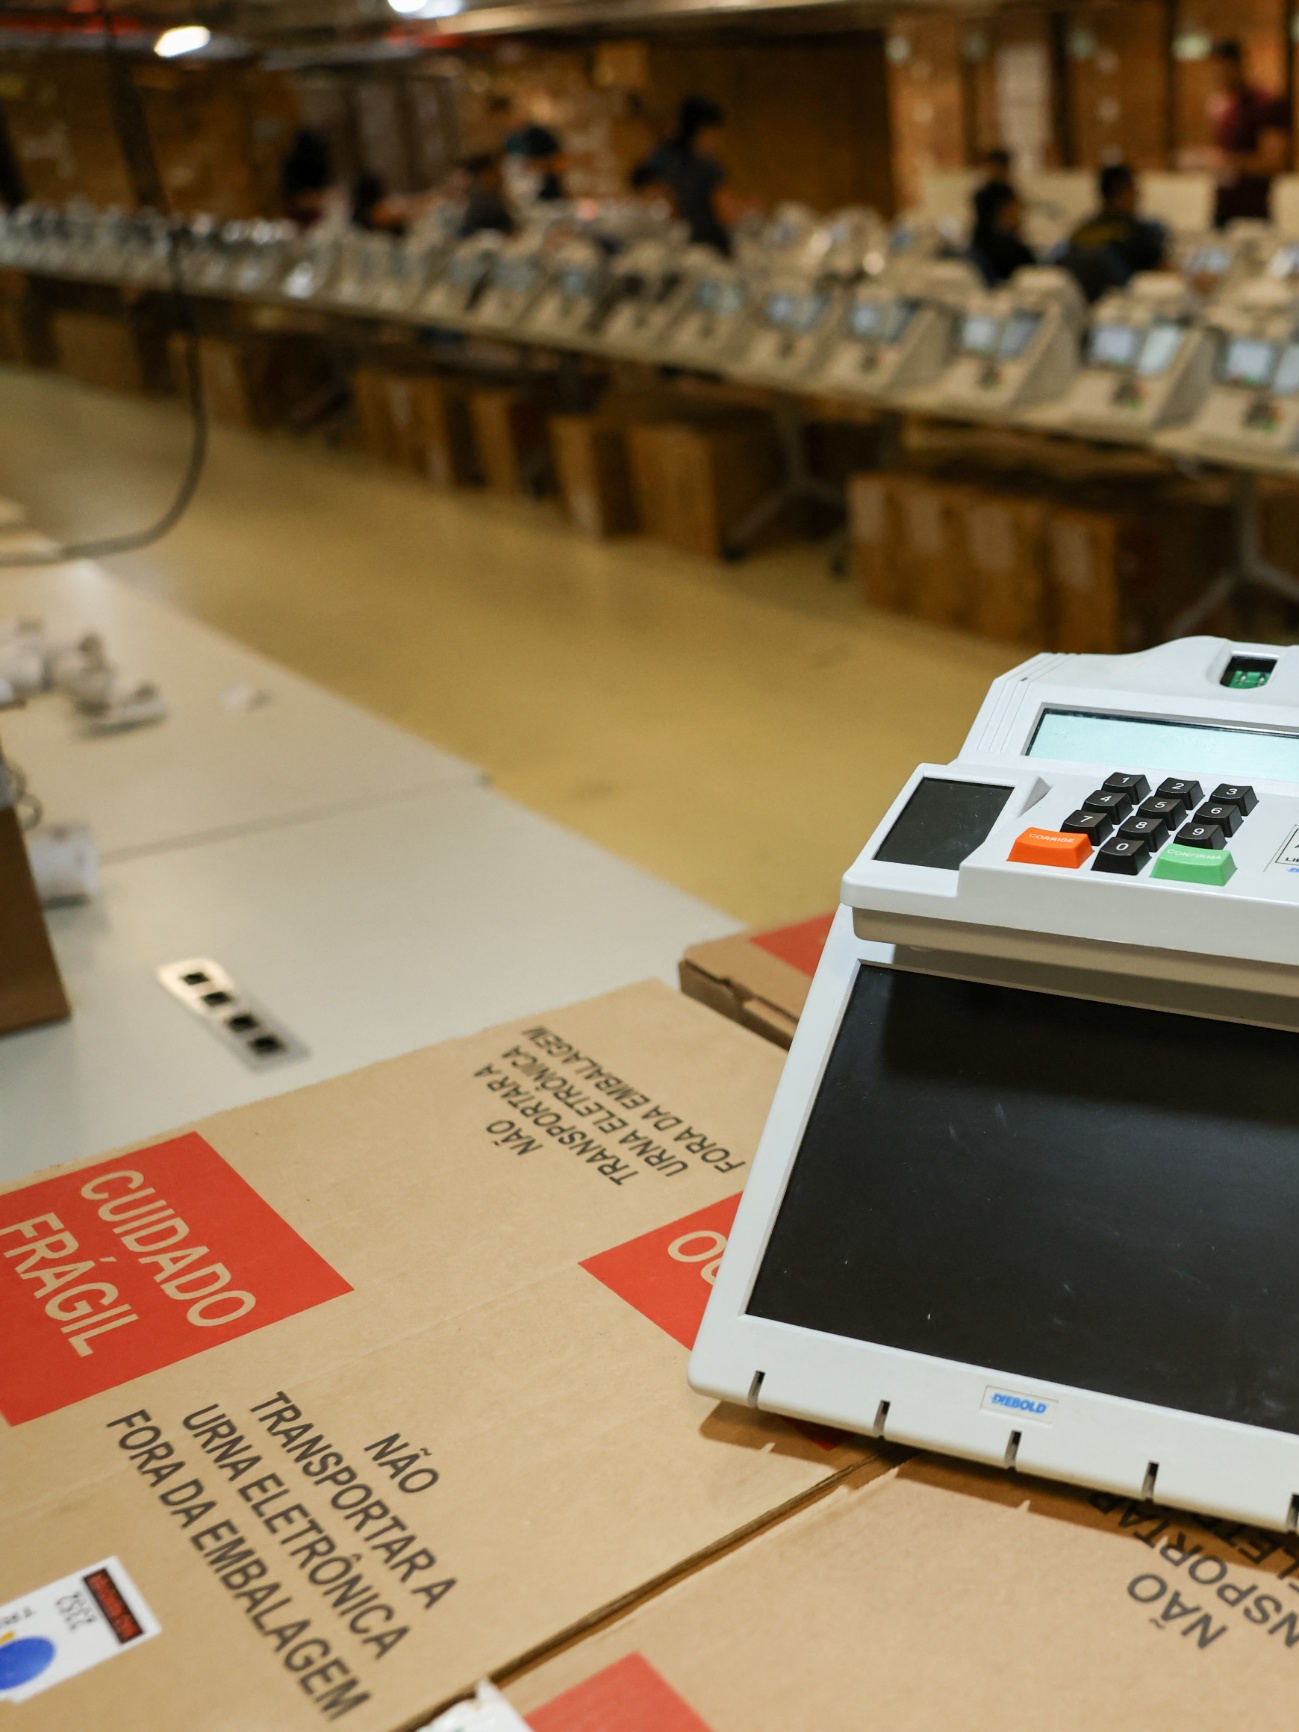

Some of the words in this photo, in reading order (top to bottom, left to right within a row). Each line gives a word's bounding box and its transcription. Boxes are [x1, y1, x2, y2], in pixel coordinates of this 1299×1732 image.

[1121, 776, 1130, 784] 1
[1172, 782, 1184, 790] 2
[1226, 787, 1238, 795] 3
[1100, 795, 1111, 803] 4
[1154, 801, 1166, 809] 5
[1082, 815, 1094, 823] 7
[1211, 807, 1222, 815] 6
[1135, 821, 1148, 830] 8
[1192, 827, 1205, 836] 9
[1028, 832, 1076, 843] CORRIGE
[1116, 842, 1129, 851] 0
[1166, 848, 1222, 861] CONFIRMA
[472, 1063, 502, 1079] A
[521, 1024, 652, 1111] EMBALAGEM
[487, 1071, 639, 1186] TRANSPORTAR
[640, 1104, 683, 1132] DA
[486, 1118, 543, 1157] NÃO
[617, 1129, 689, 1177] URNA
[673, 1126, 746, 1174] FORA
[81, 1170, 256, 1327] CUIDADO
[0, 1212, 139, 1358] FRÁGIL
[364, 1432, 440, 1494] NÃO
[250, 1391, 437, 1584] TRANSPORTAR
[411, 1577, 458, 1610] A
[182, 1403, 263, 1482] URNA
[238, 1472, 411, 1660] ELETRÔNICA
[106, 1409, 186, 1488] FORA
[158, 1478, 217, 1530] DA
[190, 1519, 373, 1721] EMBALAGEM
[1127, 1573, 1229, 1650] NÃO
